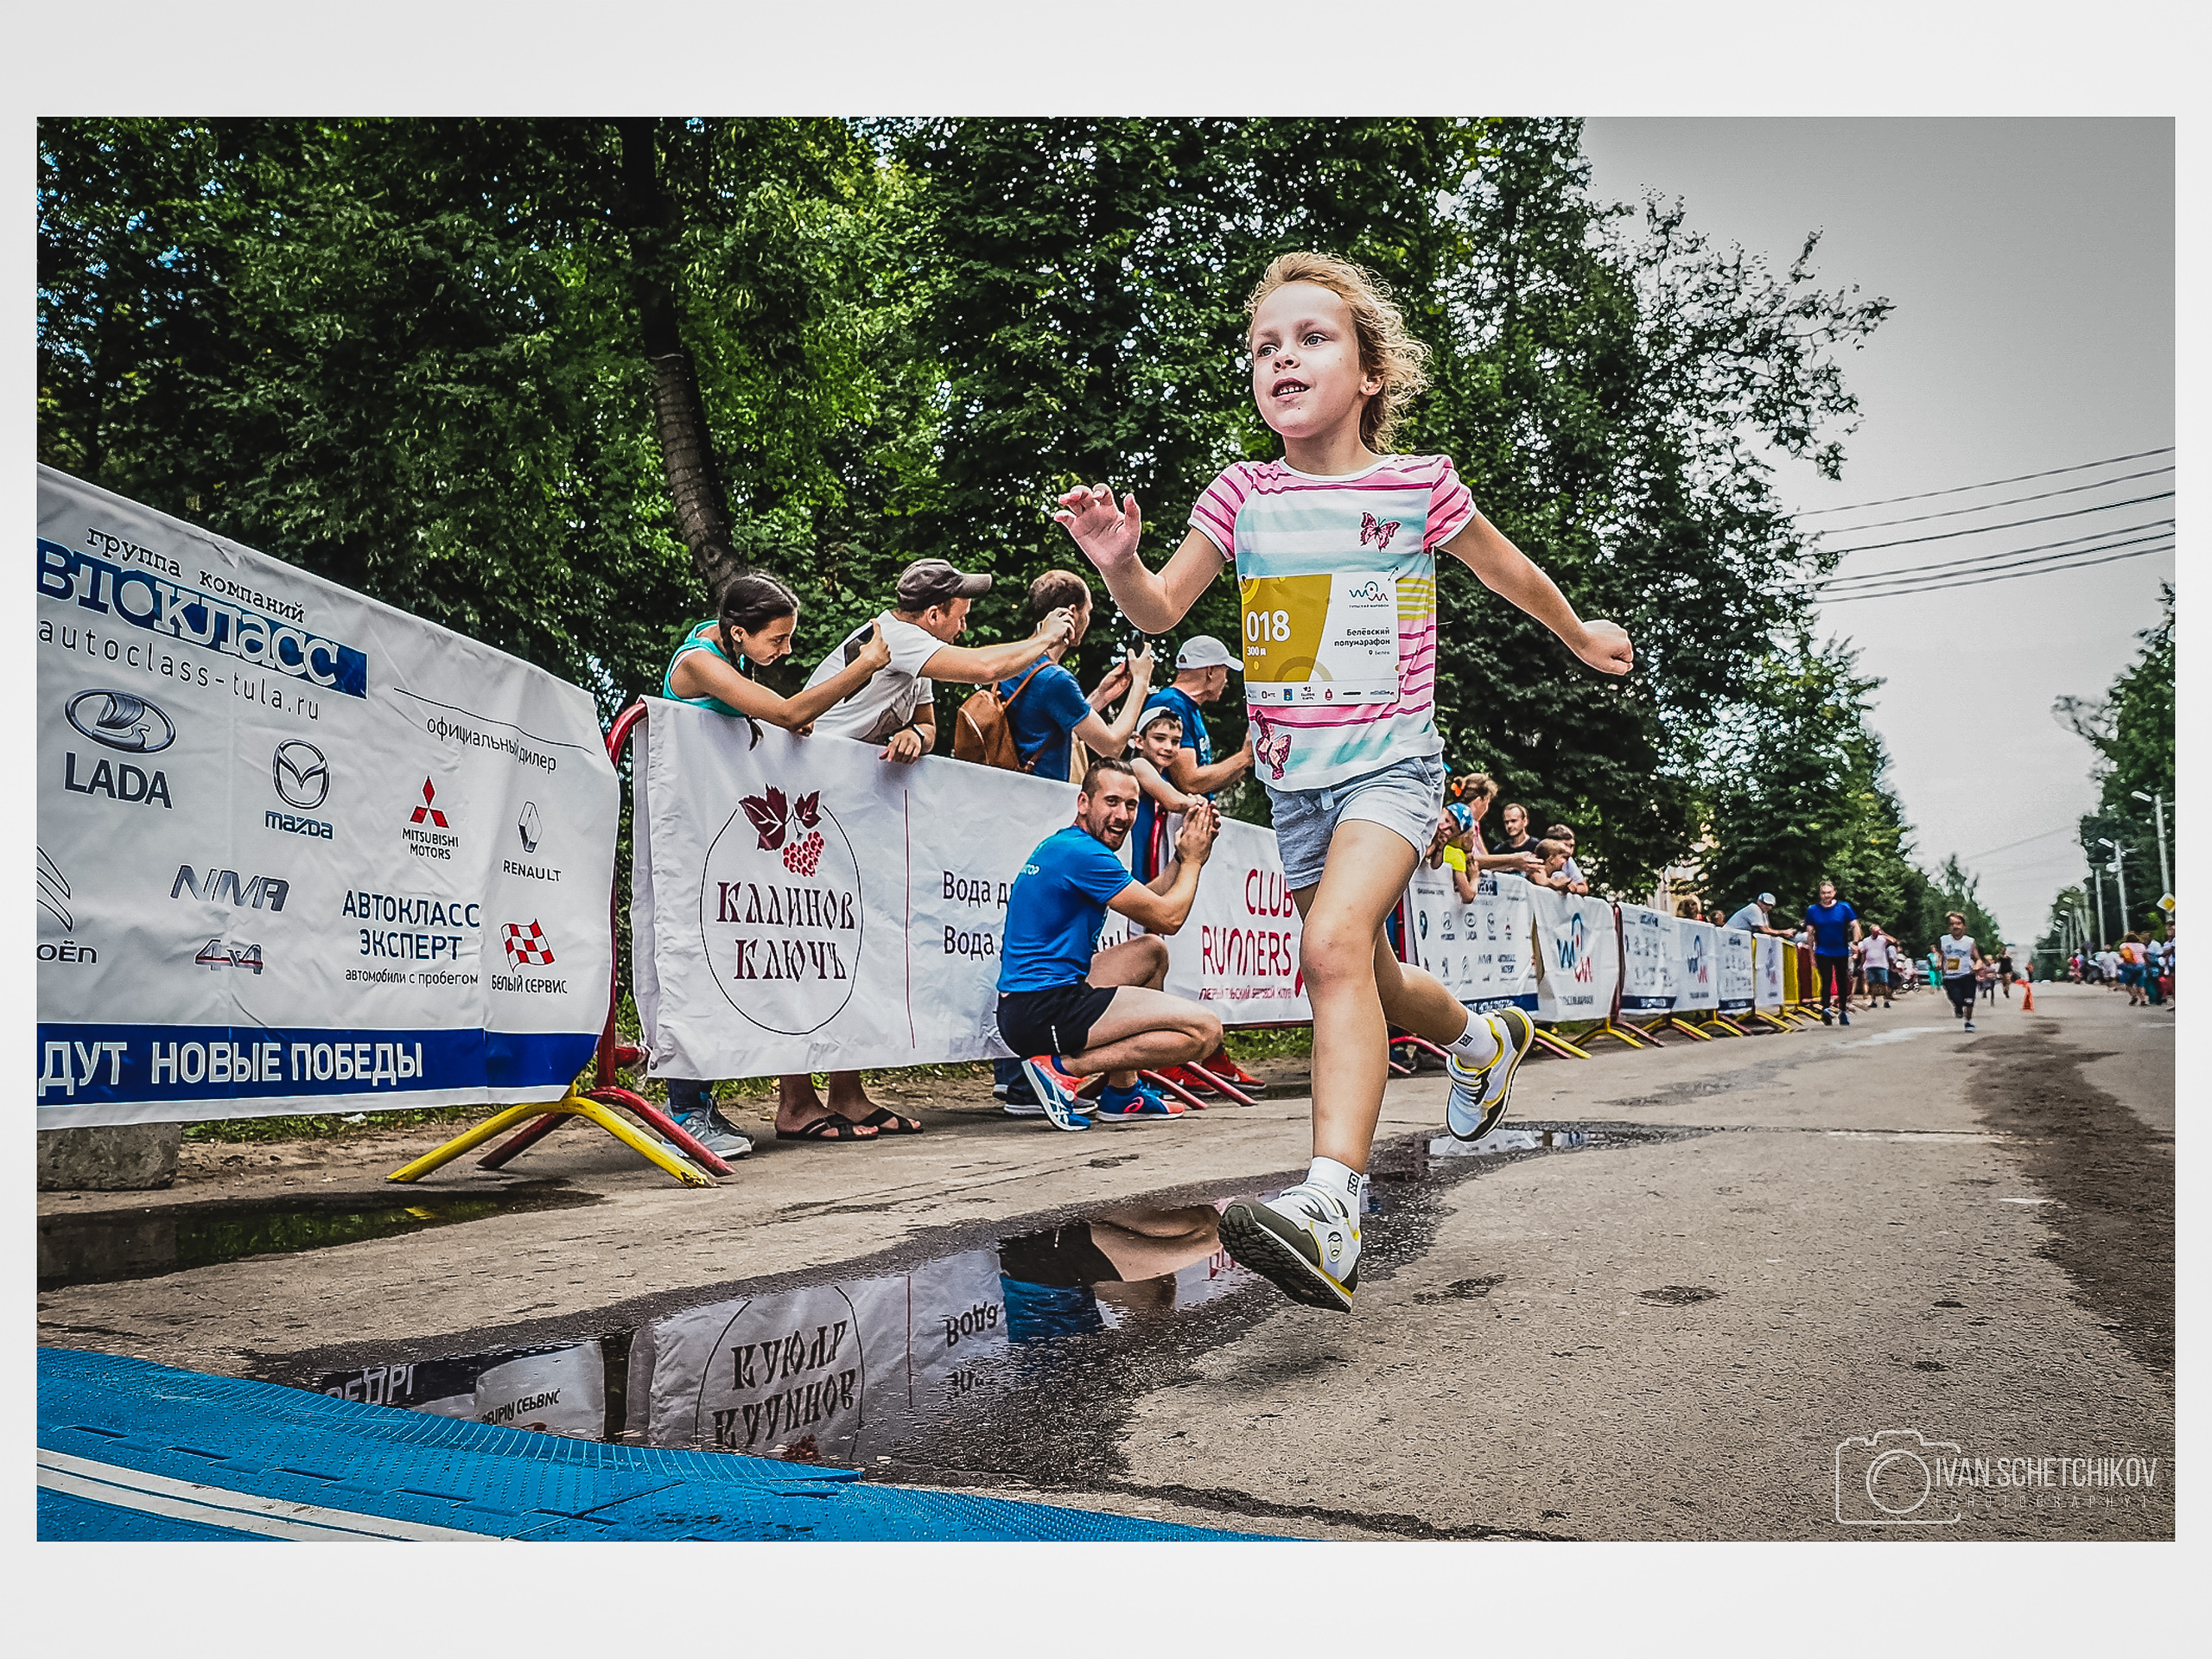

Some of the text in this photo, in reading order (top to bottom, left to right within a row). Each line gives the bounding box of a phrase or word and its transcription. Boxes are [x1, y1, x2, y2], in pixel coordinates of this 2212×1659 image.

[86, 527, 304, 624] группа компаний
[1246, 610, 1291, 642] 018
[1246, 646, 1260, 657] 300
[1334, 638, 1390, 648] полумарафон
[39, 619, 321, 721] autoclass-tula.ru
[518, 747, 556, 775] дилер
[65, 752, 173, 810] LADA
[264, 810, 334, 840] mazda
[402, 827, 459, 849] MITSUBISHI
[410, 842, 451, 860] MOTORS
[503, 859, 562, 882] RENAULT
[170, 864, 289, 912] NIVA
[942, 870, 991, 909] Вода
[1244, 868, 1294, 918] CLUB
[342, 889, 481, 928] АВТОКЛАСС
[359, 928, 463, 961] ЭКСПЕРТ
[943, 925, 995, 962] Вода
[1202, 925, 1293, 977] RUNNERS
[345, 968, 479, 988] автомобили с пробегом
[491, 974, 569, 995] БЕЛЫЙ СЕРВИС
[39, 1040, 423, 1096] ДУТ НОВЫЕ ПОБЕДЫ
